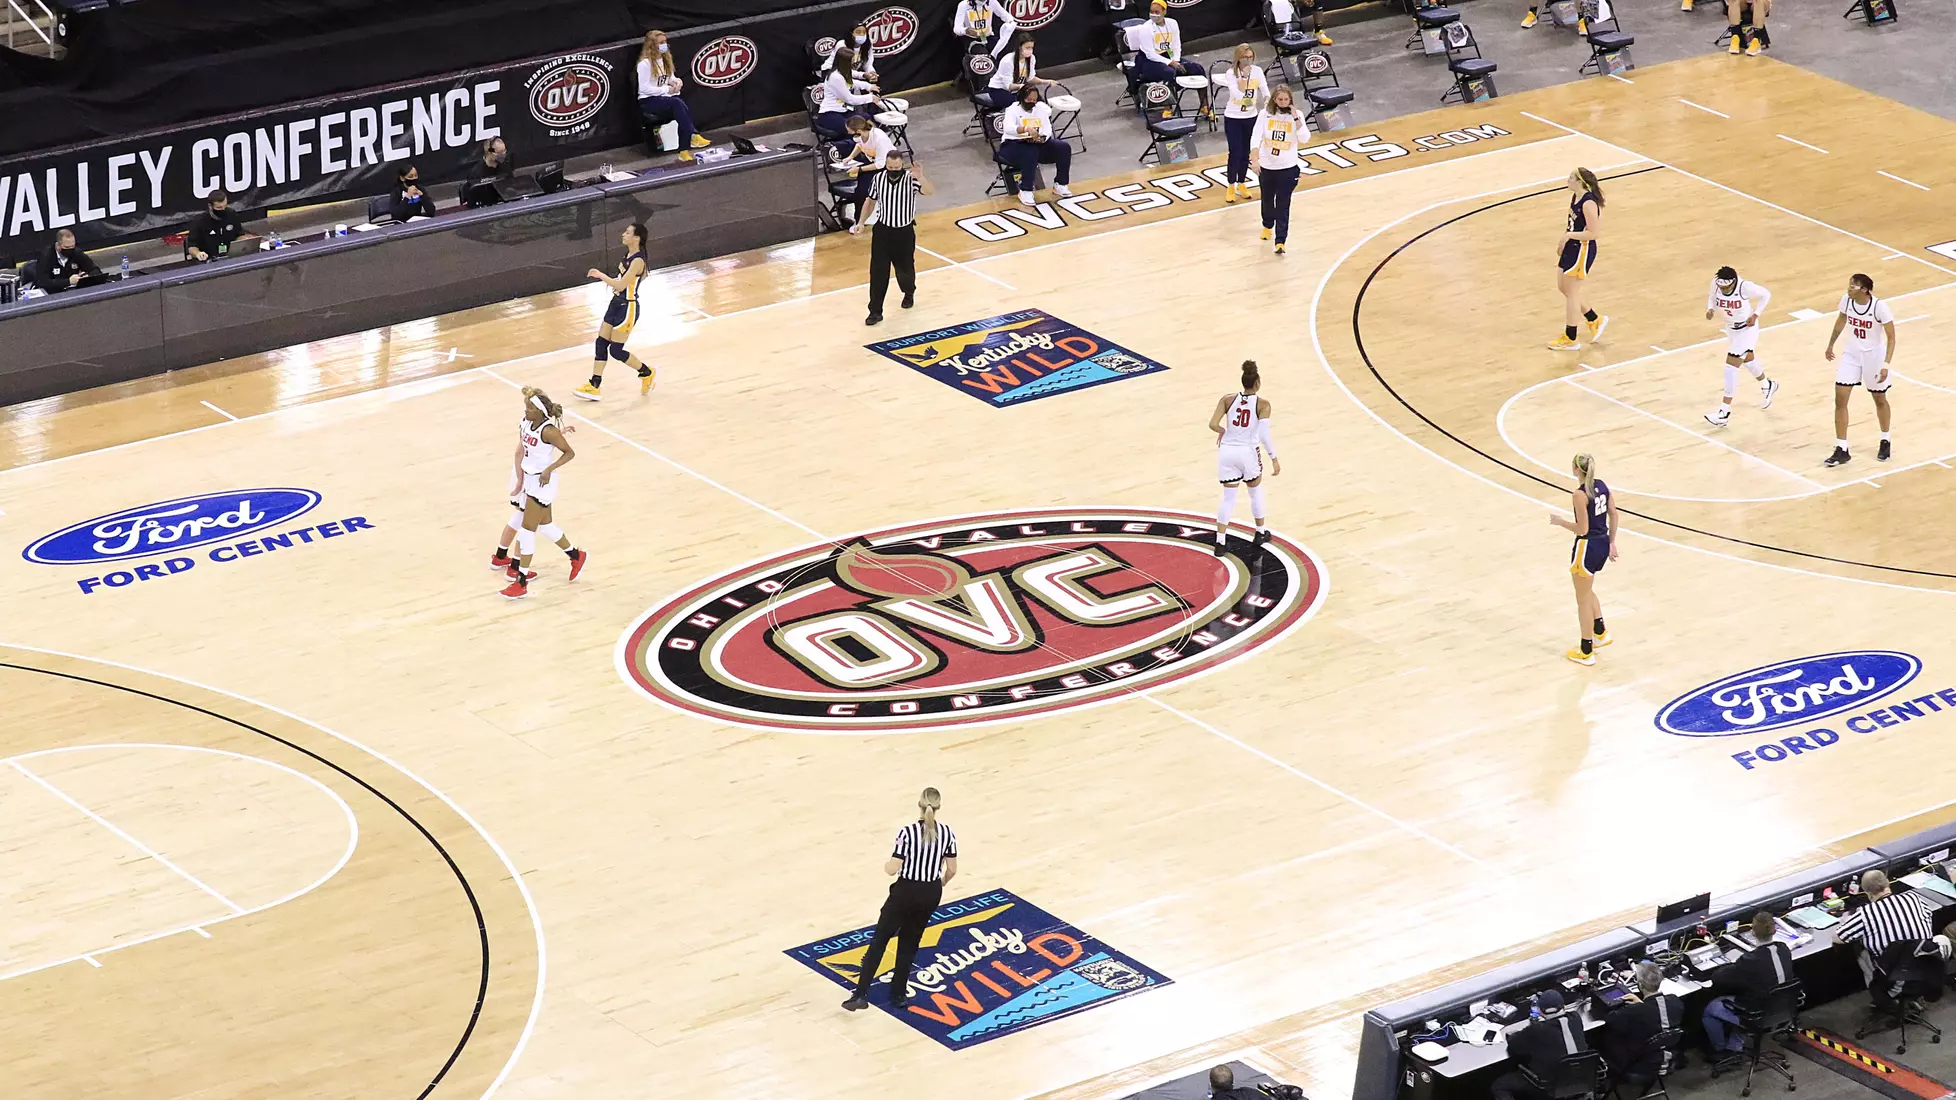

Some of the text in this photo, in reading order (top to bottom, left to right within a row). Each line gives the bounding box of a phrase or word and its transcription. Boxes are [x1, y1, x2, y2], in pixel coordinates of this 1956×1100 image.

[868, 20, 905, 44] OVC
[564, 54, 614, 72] EXCELLENCE
[705, 49, 743, 76] OVC
[546, 82, 591, 110] OVC
[192, 80, 501, 199] CONFERENCE
[1273, 130, 1285, 141] US
[887, 328, 958, 349] SUPPORT
[960, 310, 1040, 331] WILDLIFE
[1847, 315, 1873, 330] SEMO
[1853, 327, 1866, 340] 40
[939, 331, 1055, 377] Kentucky
[961, 336, 1099, 394] WILD
[1232, 407, 1251, 428] 30
[1594, 493, 1608, 517] 22
[92, 499, 267, 554] Ford
[77, 516, 377, 595] FORD CENTER
[668, 521, 1210, 652] OHIO VALLEY
[764, 544, 1190, 690] OVC
[827, 593, 1274, 717] CONFERENCE
[1710, 663, 1876, 725] Ford
[1731, 728, 1840, 770] FORD
[927, 893, 1009, 923] ILDLIFE
[907, 931, 1085, 1027] WILD
